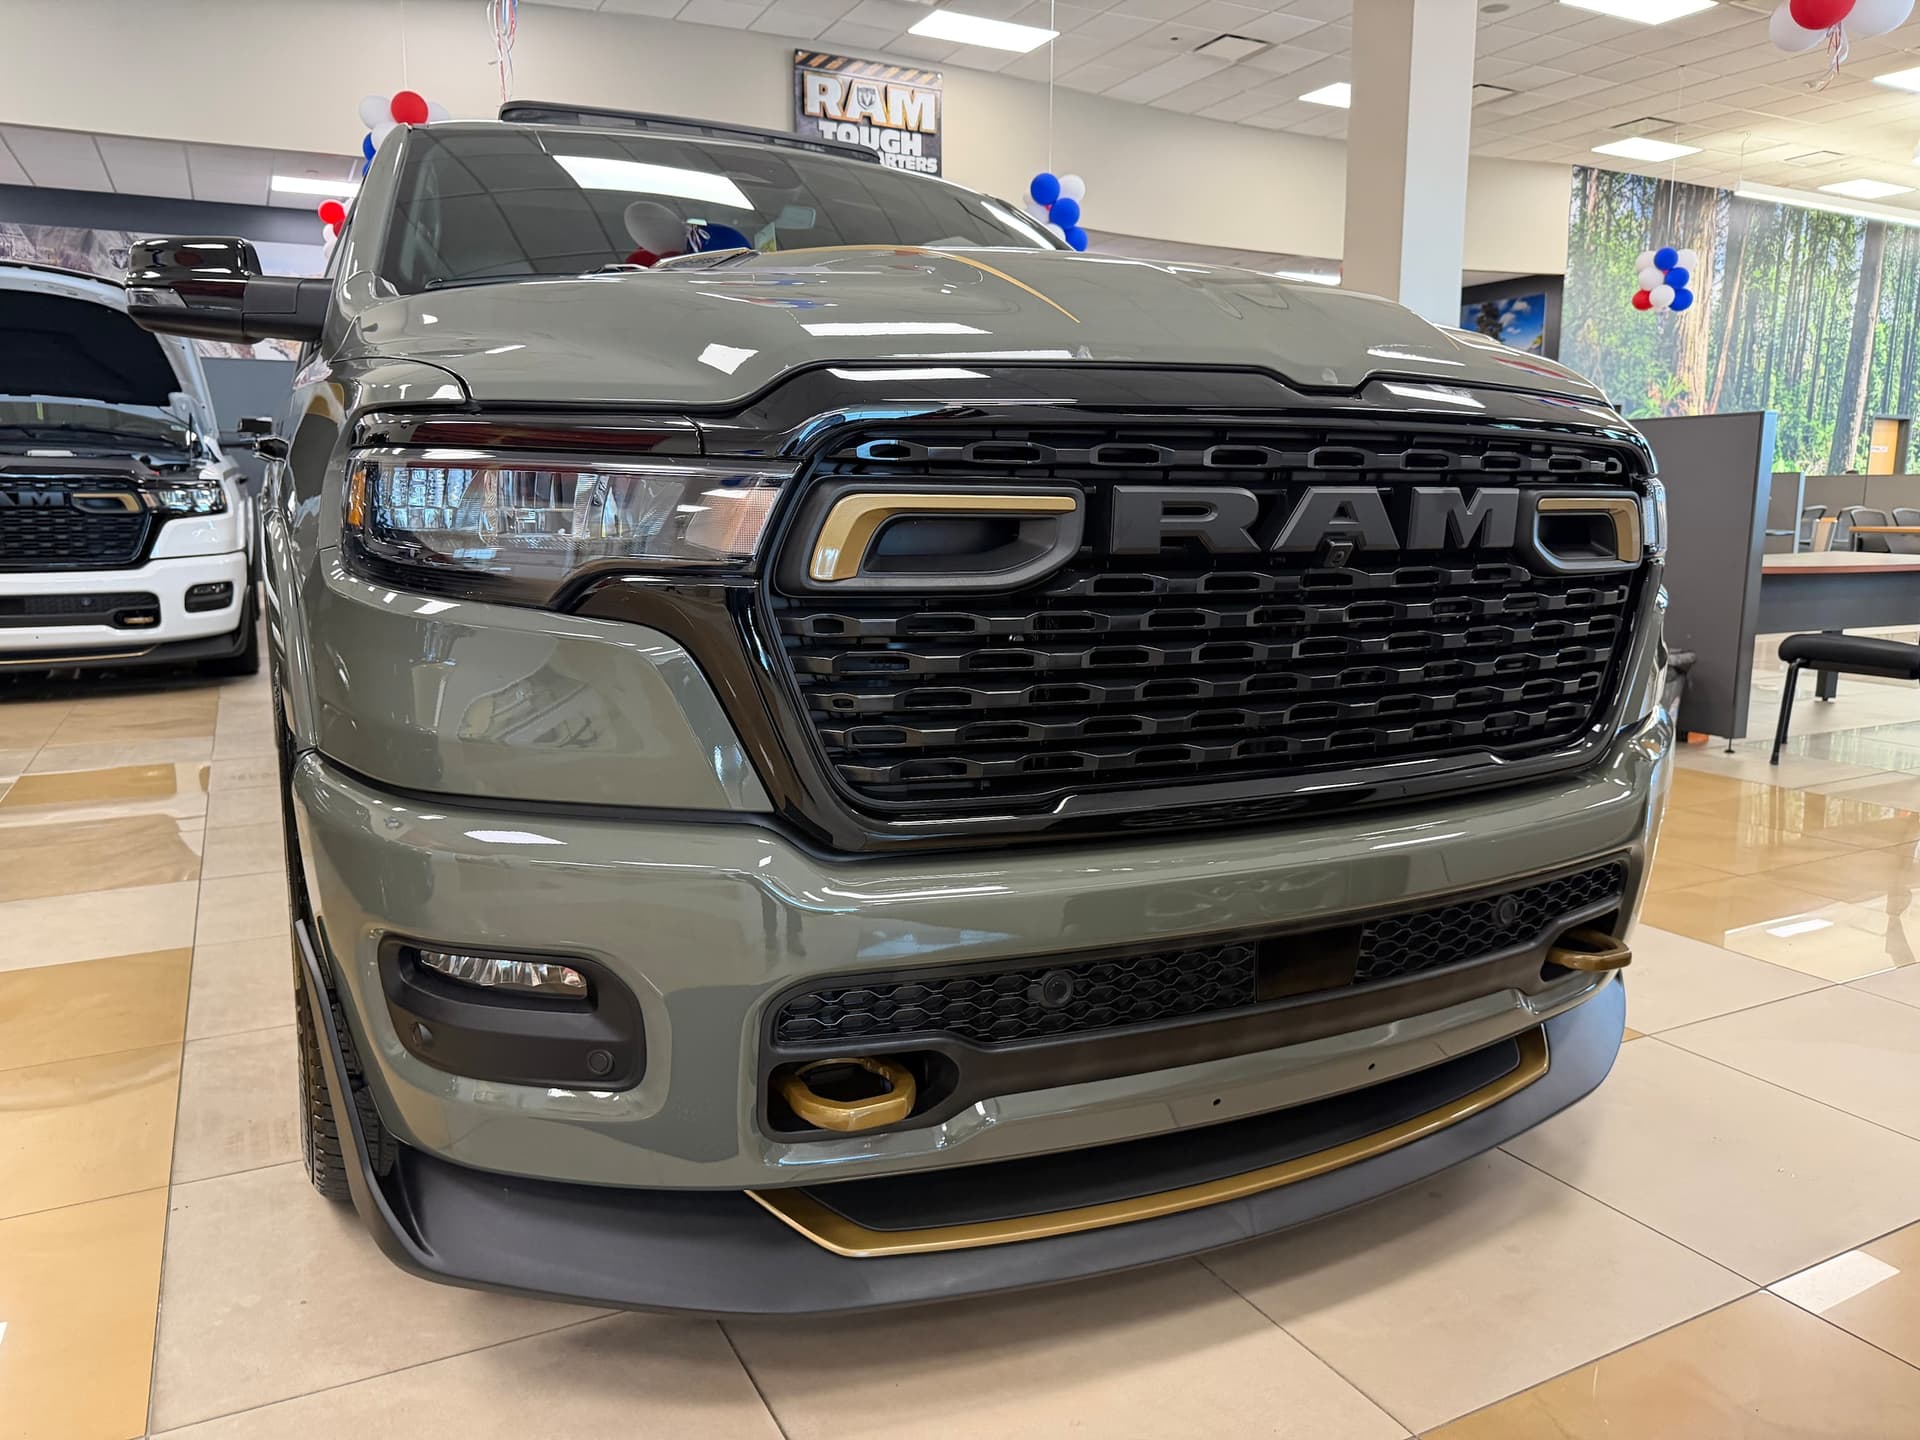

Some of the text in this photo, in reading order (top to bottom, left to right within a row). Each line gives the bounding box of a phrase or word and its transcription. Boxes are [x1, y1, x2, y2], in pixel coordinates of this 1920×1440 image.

[804, 71, 937, 133] RAM
[818, 119, 922, 156] TOUGH
[1110, 486, 1520, 554] RAM
